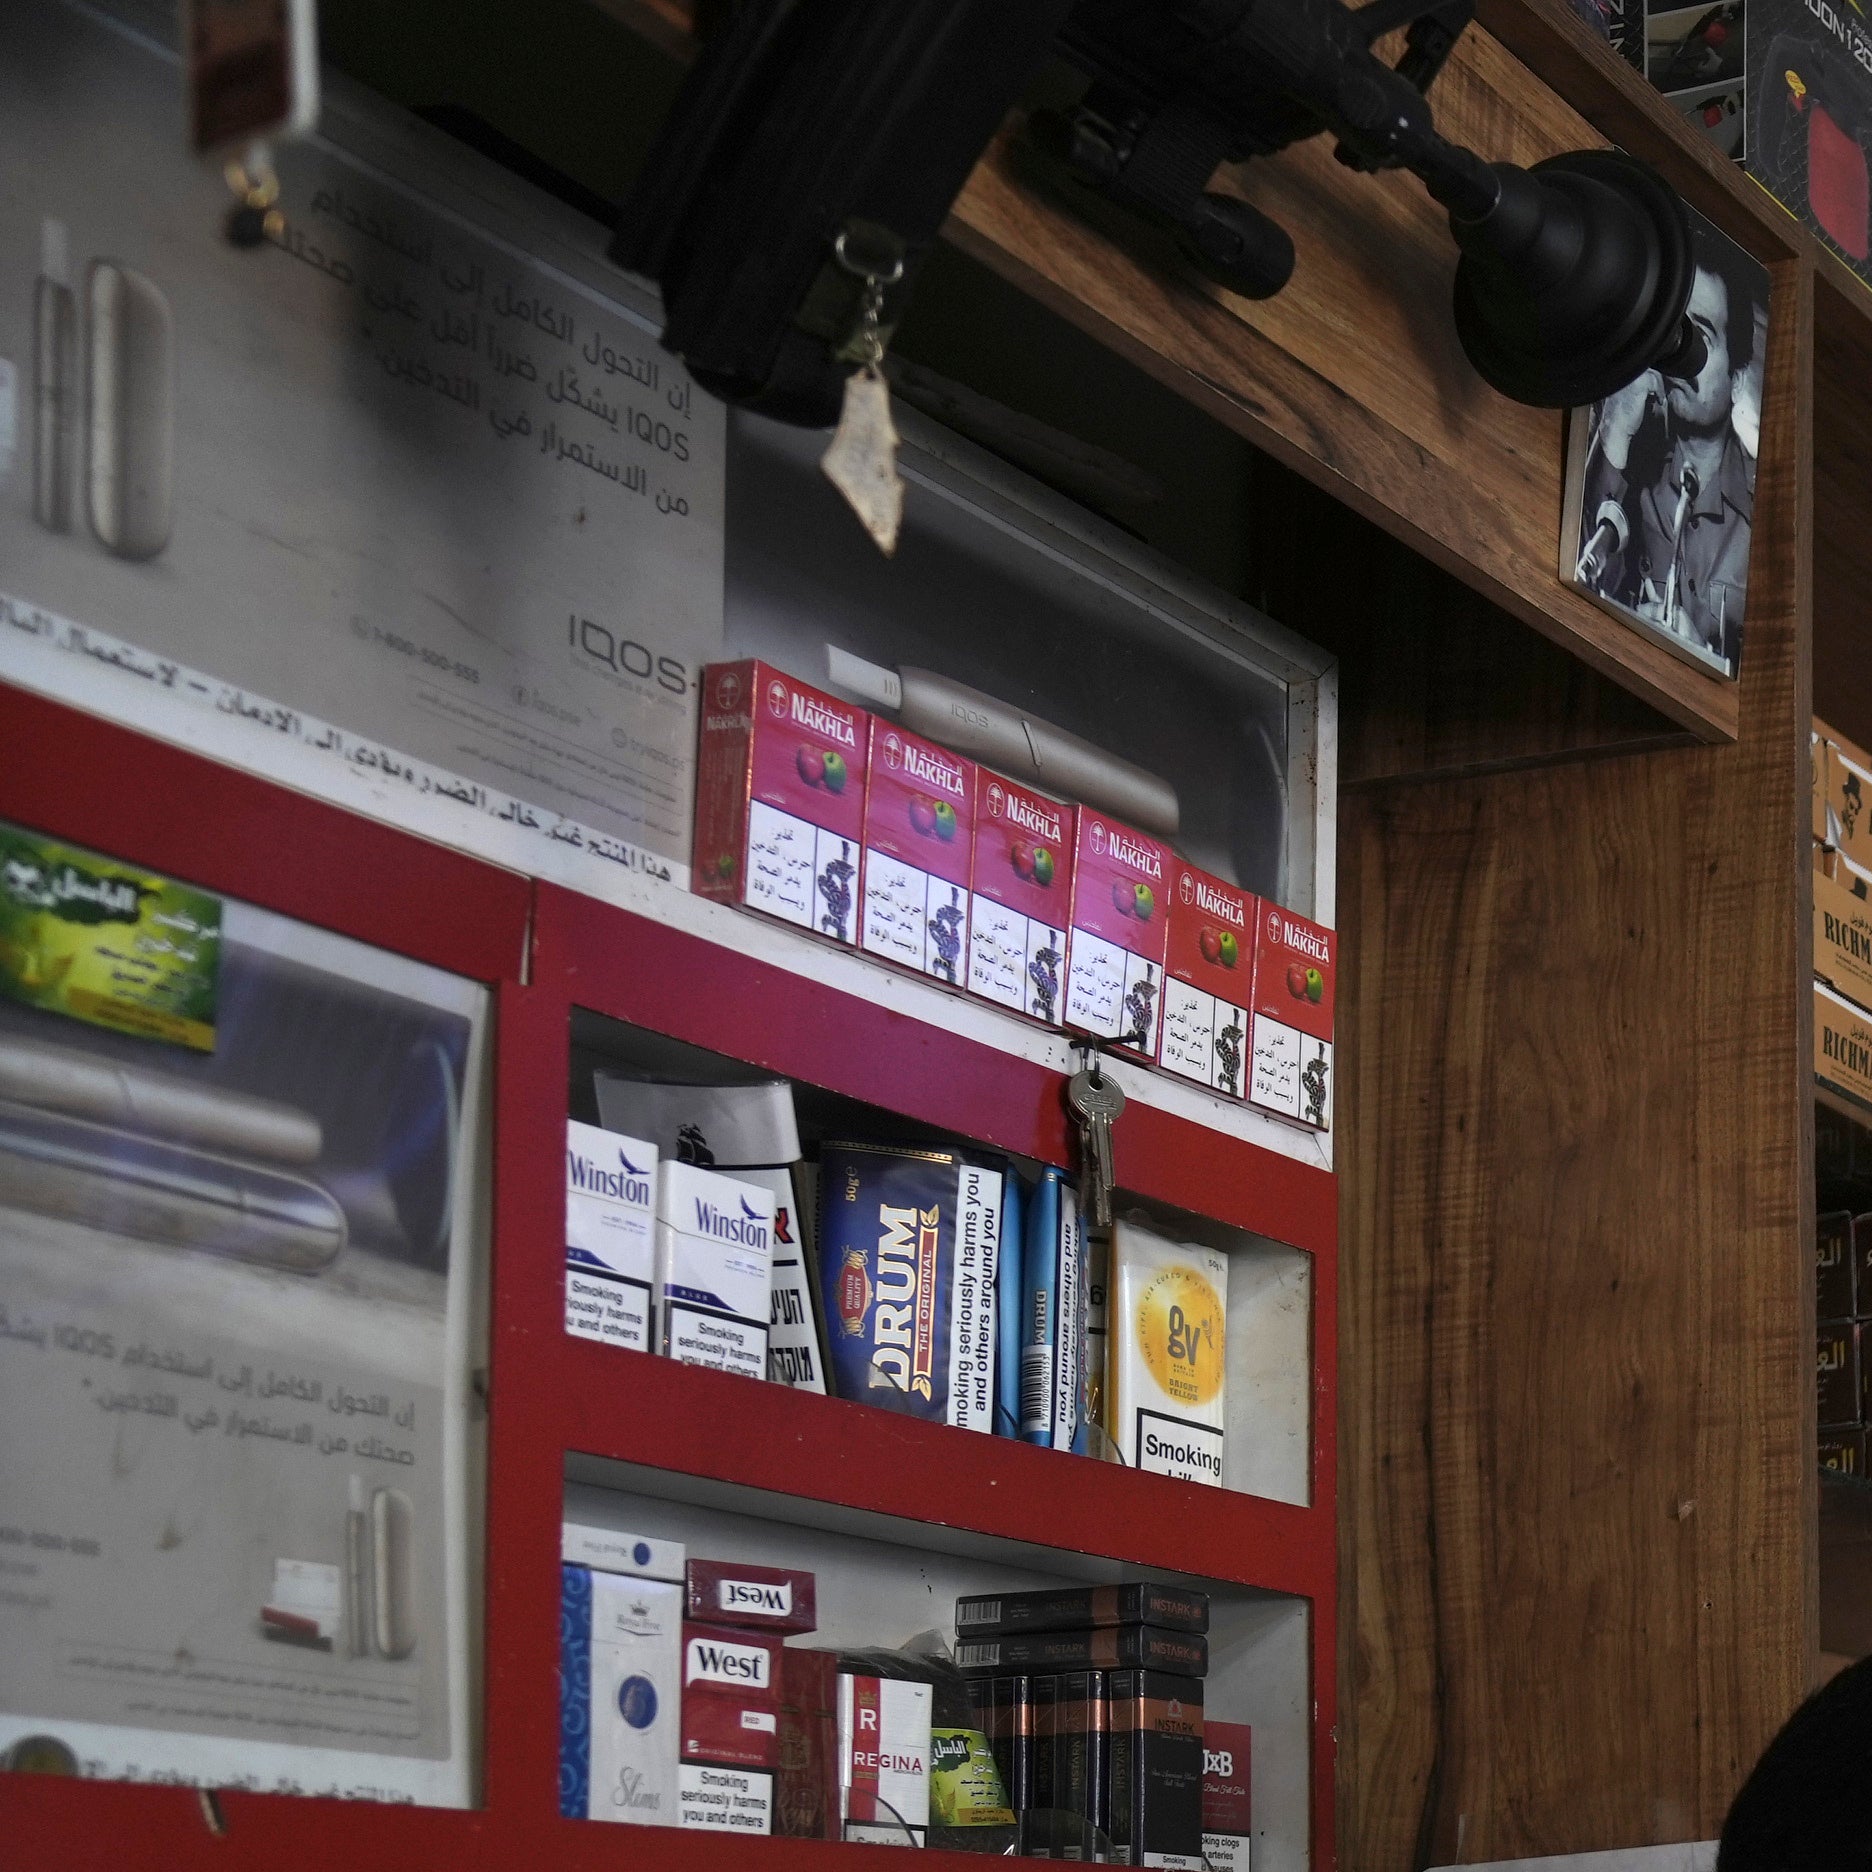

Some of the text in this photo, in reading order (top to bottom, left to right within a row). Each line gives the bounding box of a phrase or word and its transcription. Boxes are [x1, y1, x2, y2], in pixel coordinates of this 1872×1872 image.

[627, 407, 690, 462] IQOS
[569, 614, 687, 695] IQOS
[791, 692, 855, 747] NAKHLA
[904, 745, 965, 796] NAKHLA
[1007, 793, 1062, 843] NAKHLA
[1109, 831, 1162, 880] NAKHLA
[1197, 882, 1245, 927] NAKHLA
[1284, 920, 1330, 963] NAKHLA
[569, 1149, 650, 1206] Winston
[695, 1196, 767, 1250] Winston
[845, 1274, 854, 1310] PREMIUM
[869, 1203, 920, 1392] DRUM
[919, 1250, 932, 1352] THE ORIGINAL
[956, 1173, 981, 1427] moking seriously harms you
[975, 1207, 995, 1412] and others around you
[678, 1337, 761, 1364] seriously harms
[698, 1322, 745, 1346] Smoking
[1166, 1304, 1200, 1366] gv
[1145, 1433, 1221, 1477] Smoking
[728, 1585, 786, 1611] West
[695, 1645, 763, 1680] West
[1154, 1718, 1194, 1734] INSTARK
[700, 1771, 749, 1792] Smoking
[853, 1752, 924, 1773] REGINA
